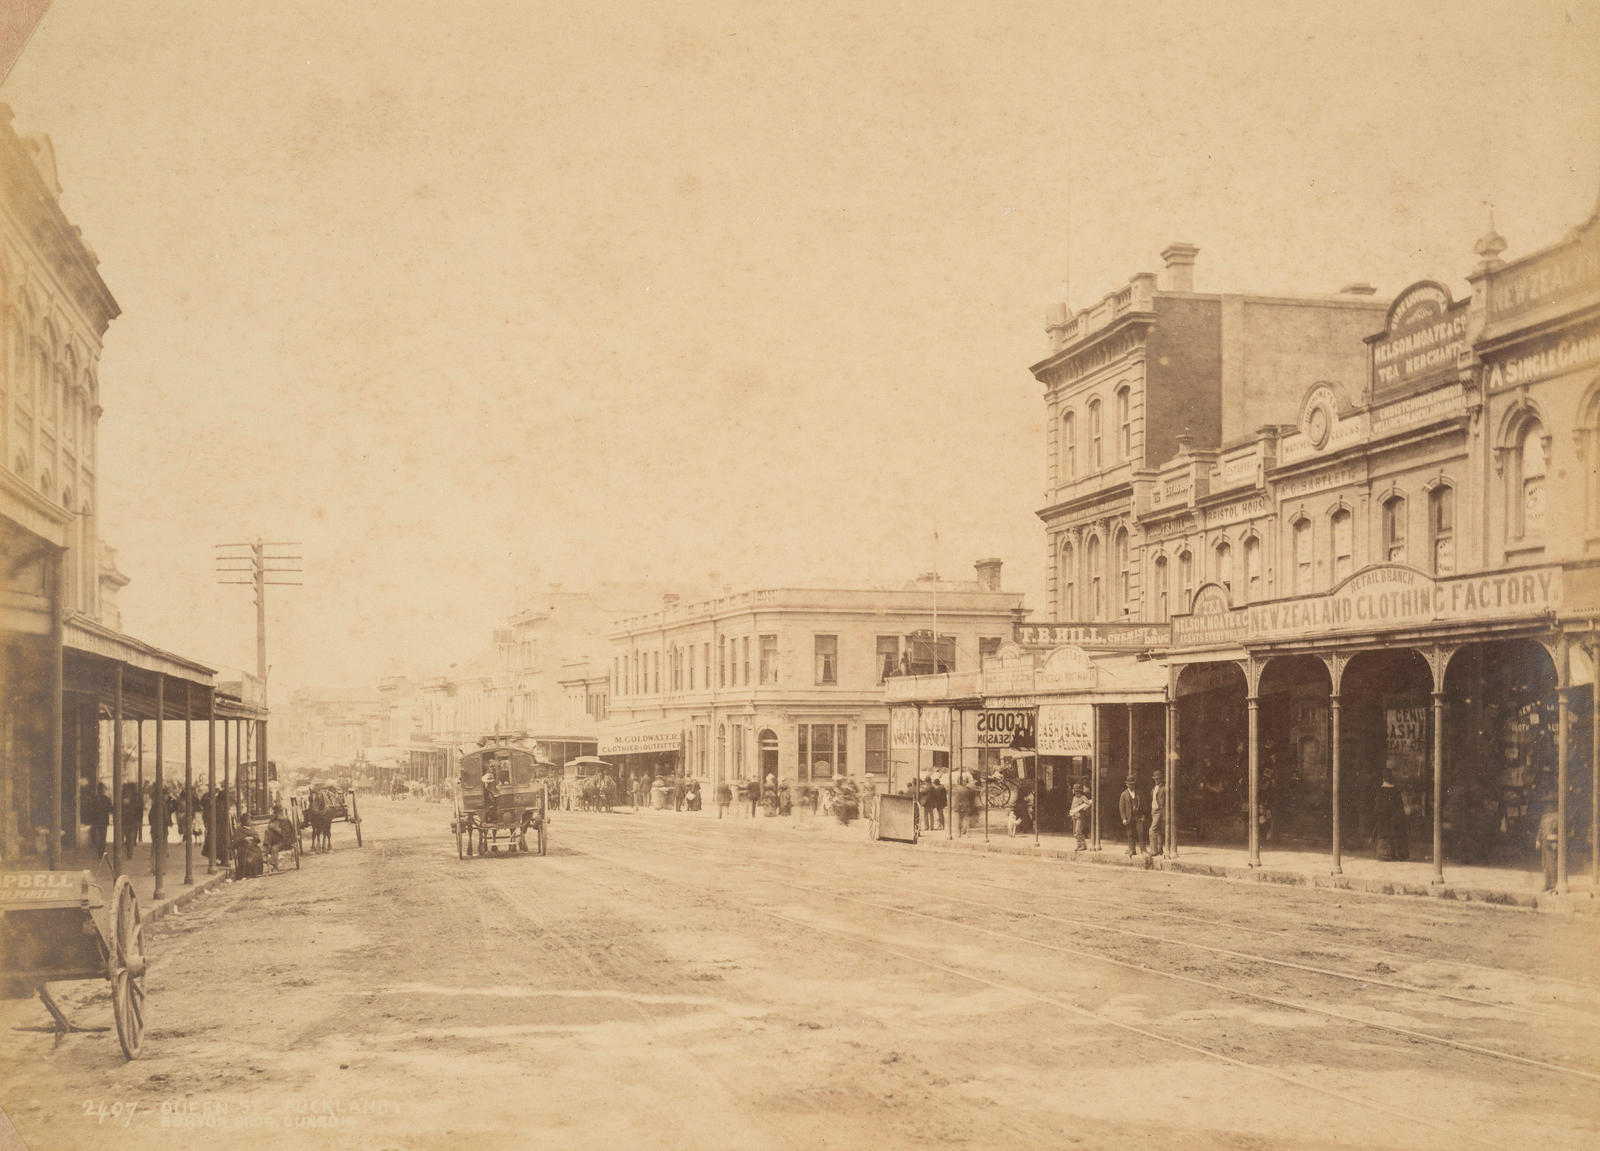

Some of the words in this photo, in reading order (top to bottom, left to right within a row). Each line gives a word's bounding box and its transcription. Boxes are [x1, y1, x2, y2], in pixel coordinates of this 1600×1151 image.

[1378, 364, 1399, 382] TEA
[1490, 362, 1503, 389] A
[1207, 505, 1239, 523] BRISTOL
[1351, 572, 1380, 593] RETAIL
[1380, 570, 1414, 586] BRANCH
[1251, 607, 1280, 633] NEW
[1282, 597, 1352, 629] ZEALAND
[1356, 586, 1445, 620] CLOTHING
[602, 744, 639, 754] CLOTHIER
[3, 874, 73, 888] PBELL
